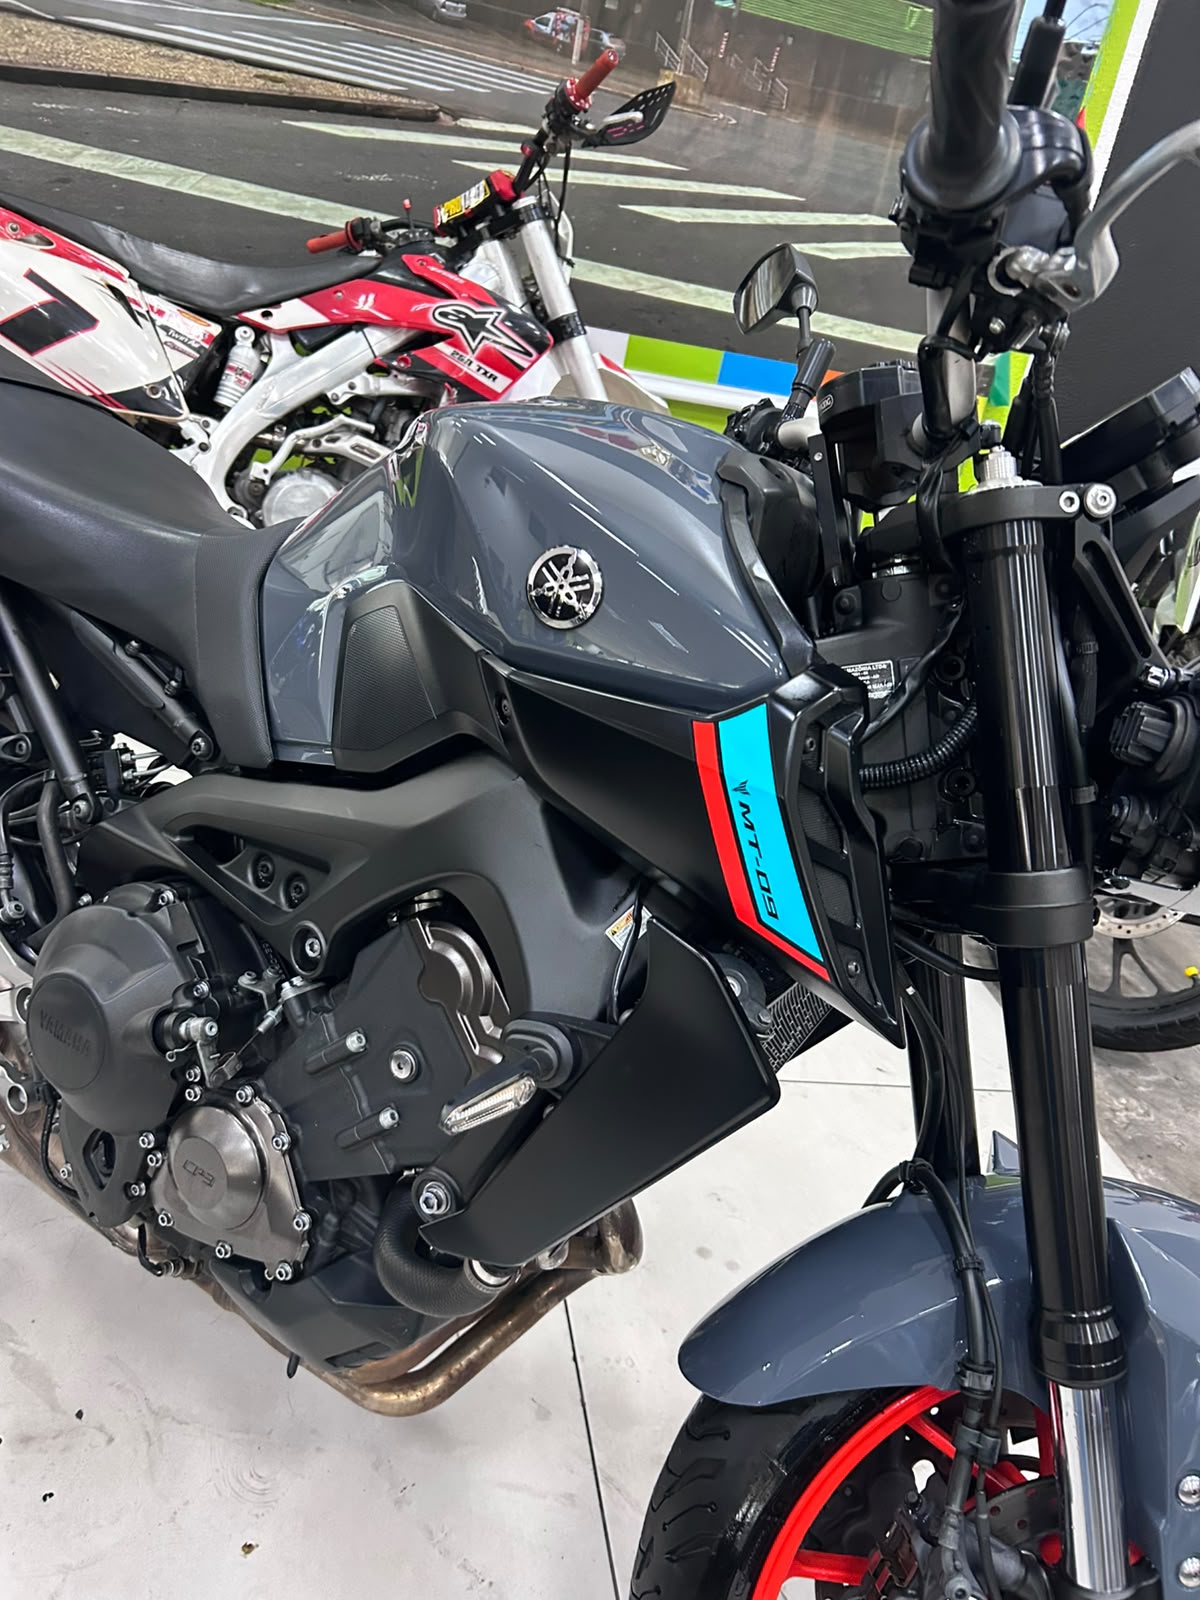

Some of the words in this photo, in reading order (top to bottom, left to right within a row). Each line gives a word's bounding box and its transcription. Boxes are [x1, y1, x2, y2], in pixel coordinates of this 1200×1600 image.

[476, 363, 498, 382] TXR
[739, 801, 779, 920] MT-09
[40, 1007, 90, 1057] YAMAHA
